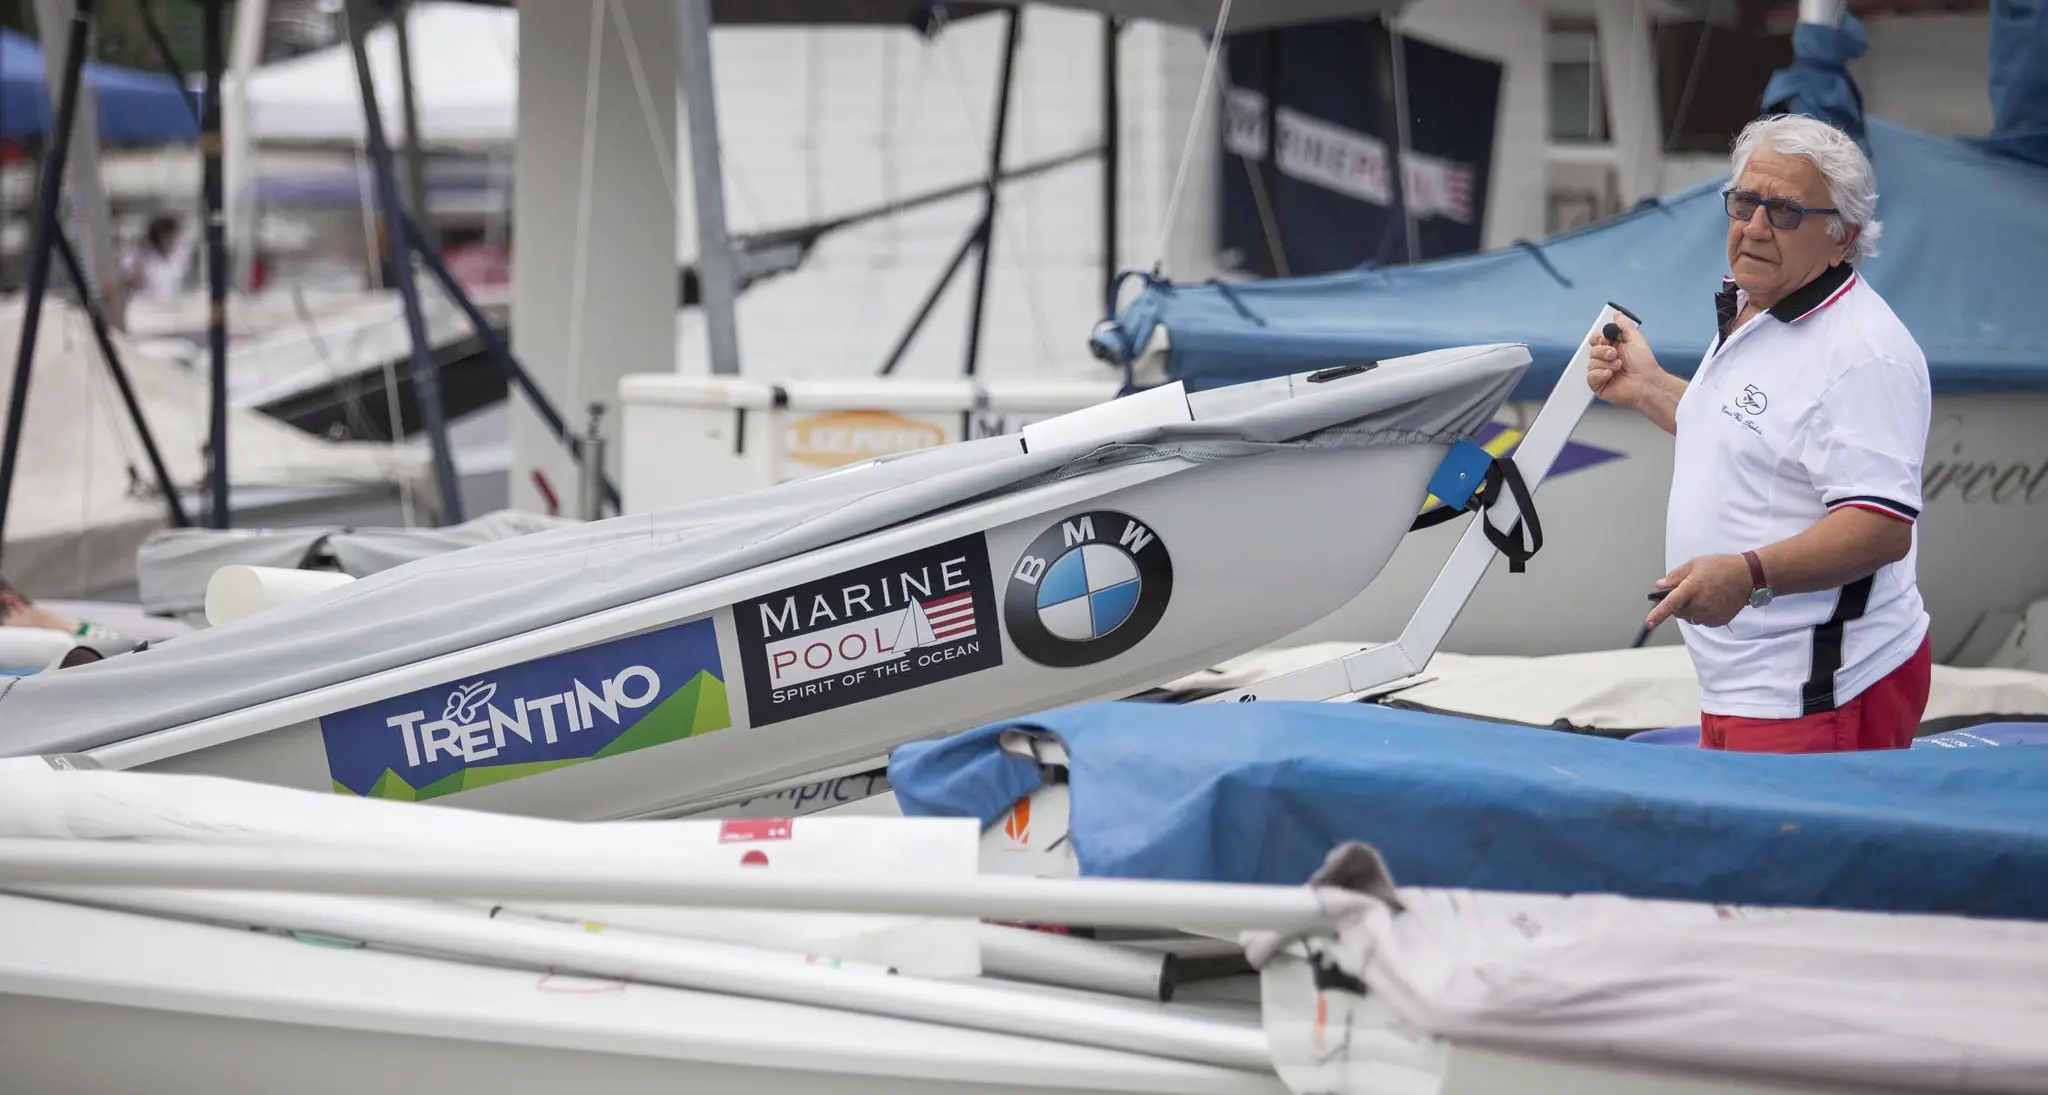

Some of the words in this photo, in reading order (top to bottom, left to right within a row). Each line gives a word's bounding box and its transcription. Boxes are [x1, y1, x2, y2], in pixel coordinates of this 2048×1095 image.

[1014, 515, 1154, 586] BMW
[758, 555, 971, 638] MARINE
[772, 679, 834, 704] SPIRIT
[842, 671, 867, 687] OF
[873, 659, 911, 678] THE
[918, 641, 980, 667] OCEAN
[773, 627, 894, 680] POOL
[386, 665, 661, 767] TRENTINO
